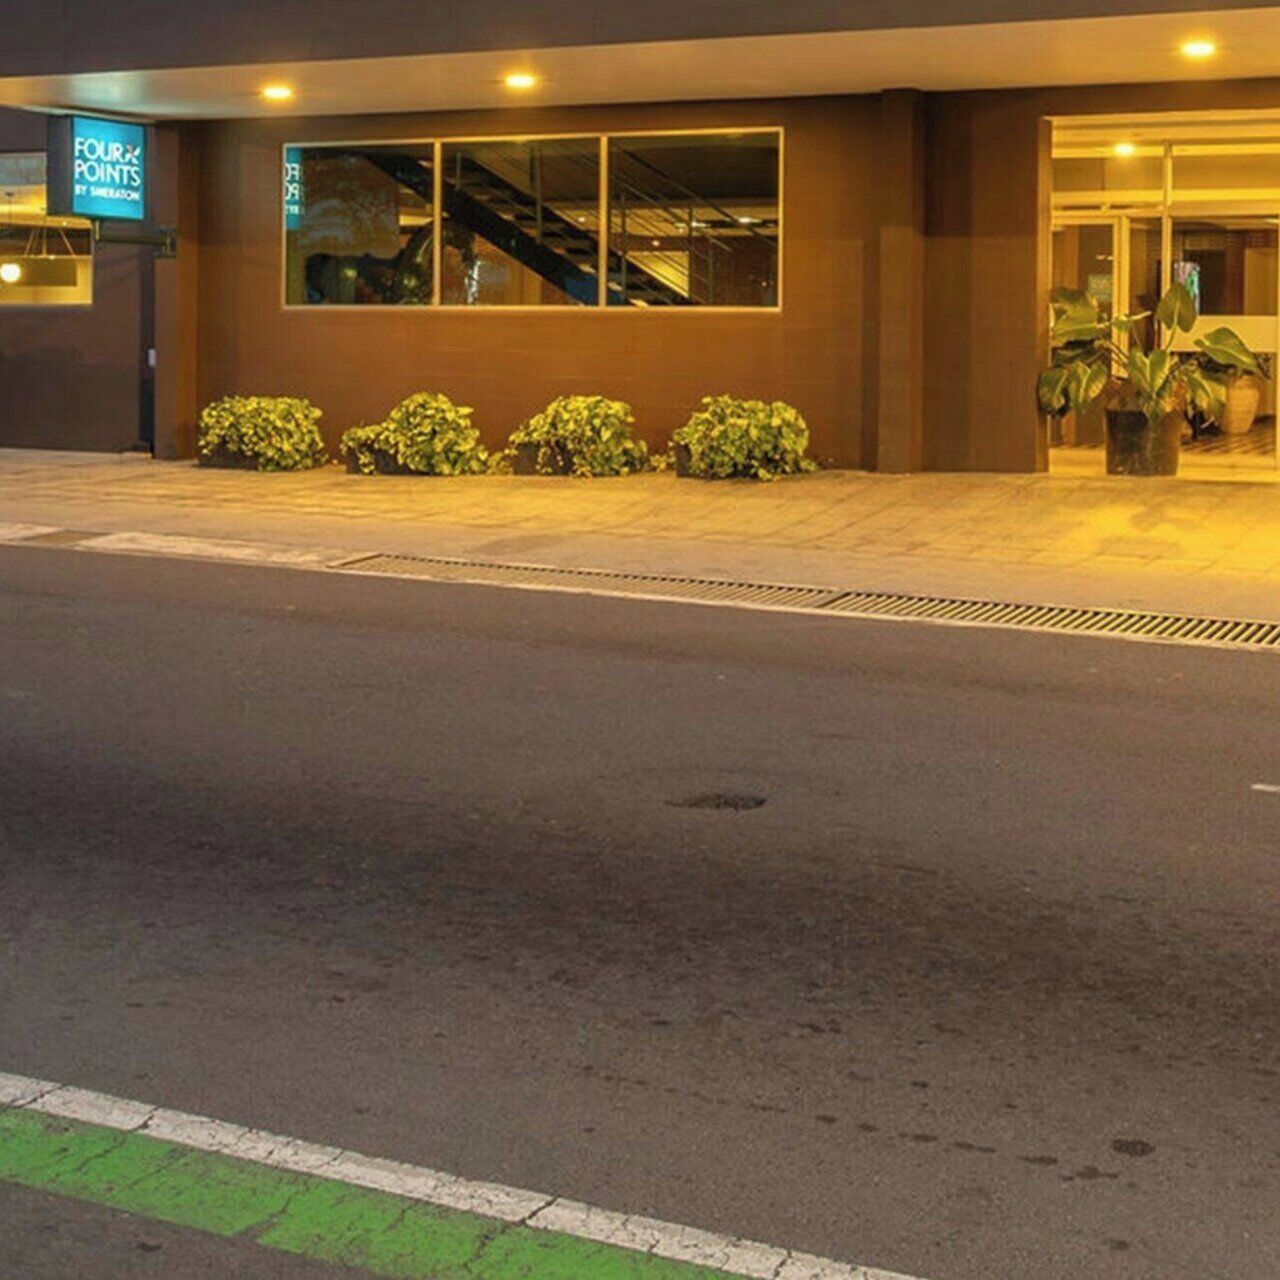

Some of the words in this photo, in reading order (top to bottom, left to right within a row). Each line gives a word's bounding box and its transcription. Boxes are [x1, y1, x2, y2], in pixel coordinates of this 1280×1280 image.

[75, 137, 125, 163] FOUR
[75, 159, 141, 187] POINTS
[75, 184, 87, 196] BY
